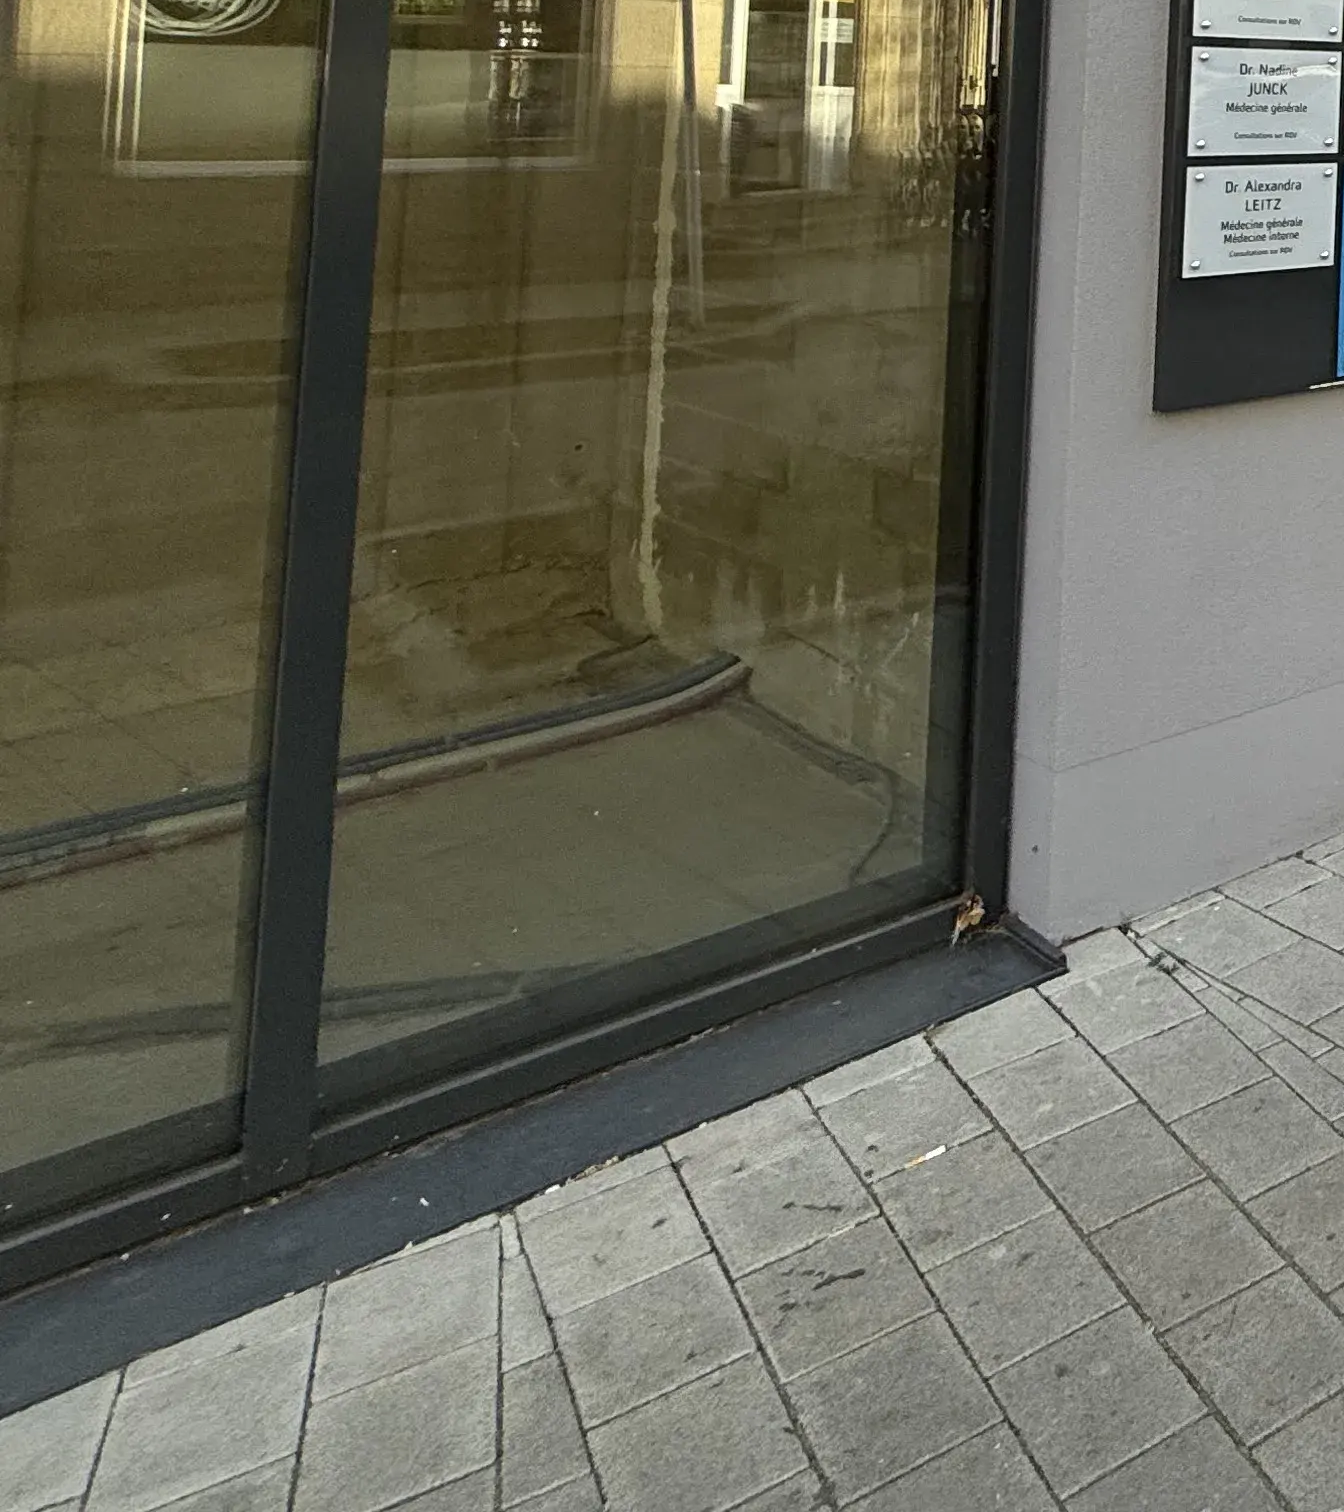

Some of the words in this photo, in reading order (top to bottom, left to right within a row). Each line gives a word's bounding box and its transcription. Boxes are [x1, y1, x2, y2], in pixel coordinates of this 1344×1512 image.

[1240, 63, 1255, 75] Dr.
[1259, 64, 1298, 76] Nadine
[1247, 83, 1288, 97] JUNCK
[1226, 102, 1268, 112] Médecine
[1225, 181, 1241, 193] Dr.
[1245, 179, 1302, 192] Alexandra
[1245, 198, 1282, 211] LEITZ
